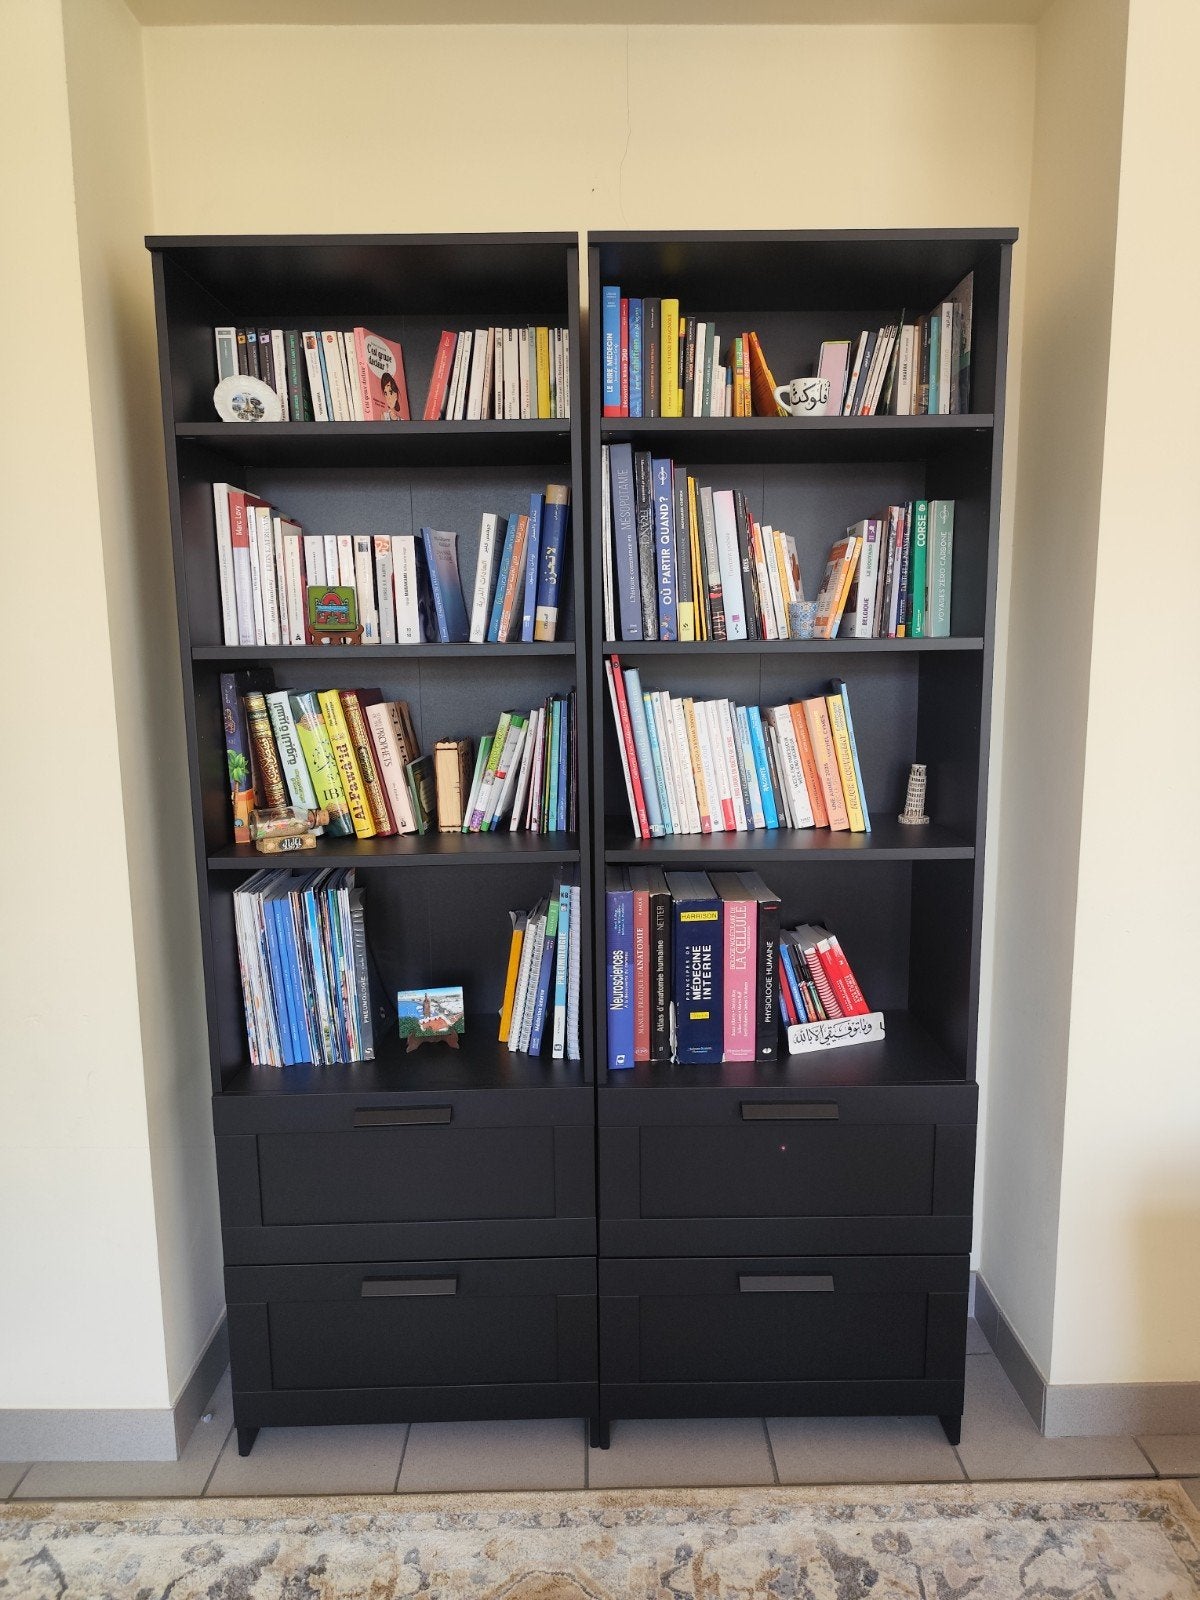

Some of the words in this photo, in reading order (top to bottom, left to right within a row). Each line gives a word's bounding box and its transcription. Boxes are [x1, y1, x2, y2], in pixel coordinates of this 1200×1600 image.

[235, 520, 243, 535] Marc
[917, 514, 925, 546] CORSE
[546, 546, 556, 554] لا
[544, 555, 557, 584] تحزن
[661, 549, 671, 584] PARTIR
[660, 588, 671, 605] OÙ
[273, 702, 290, 732] السيرة
[281, 733, 298, 765] النبوية
[376, 726, 391, 767] PROPHETS
[656, 905, 664, 930] NETTER
[735, 905, 746, 953] CELLULE
[557, 932, 566, 985] PNEUMOLOGIE
[656, 939, 664, 971] humaine
[736, 957, 746, 969] LA
[765, 941, 773, 974] HUMAINE
[608, 949, 625, 1009] Neurosciences
[690, 945, 701, 1000] MÉDECINE
[703, 945, 712, 1000] INTERNE
[656, 973, 664, 1011] d'anatomie
[764, 976, 772, 1022] PHYSIOLOGIE
